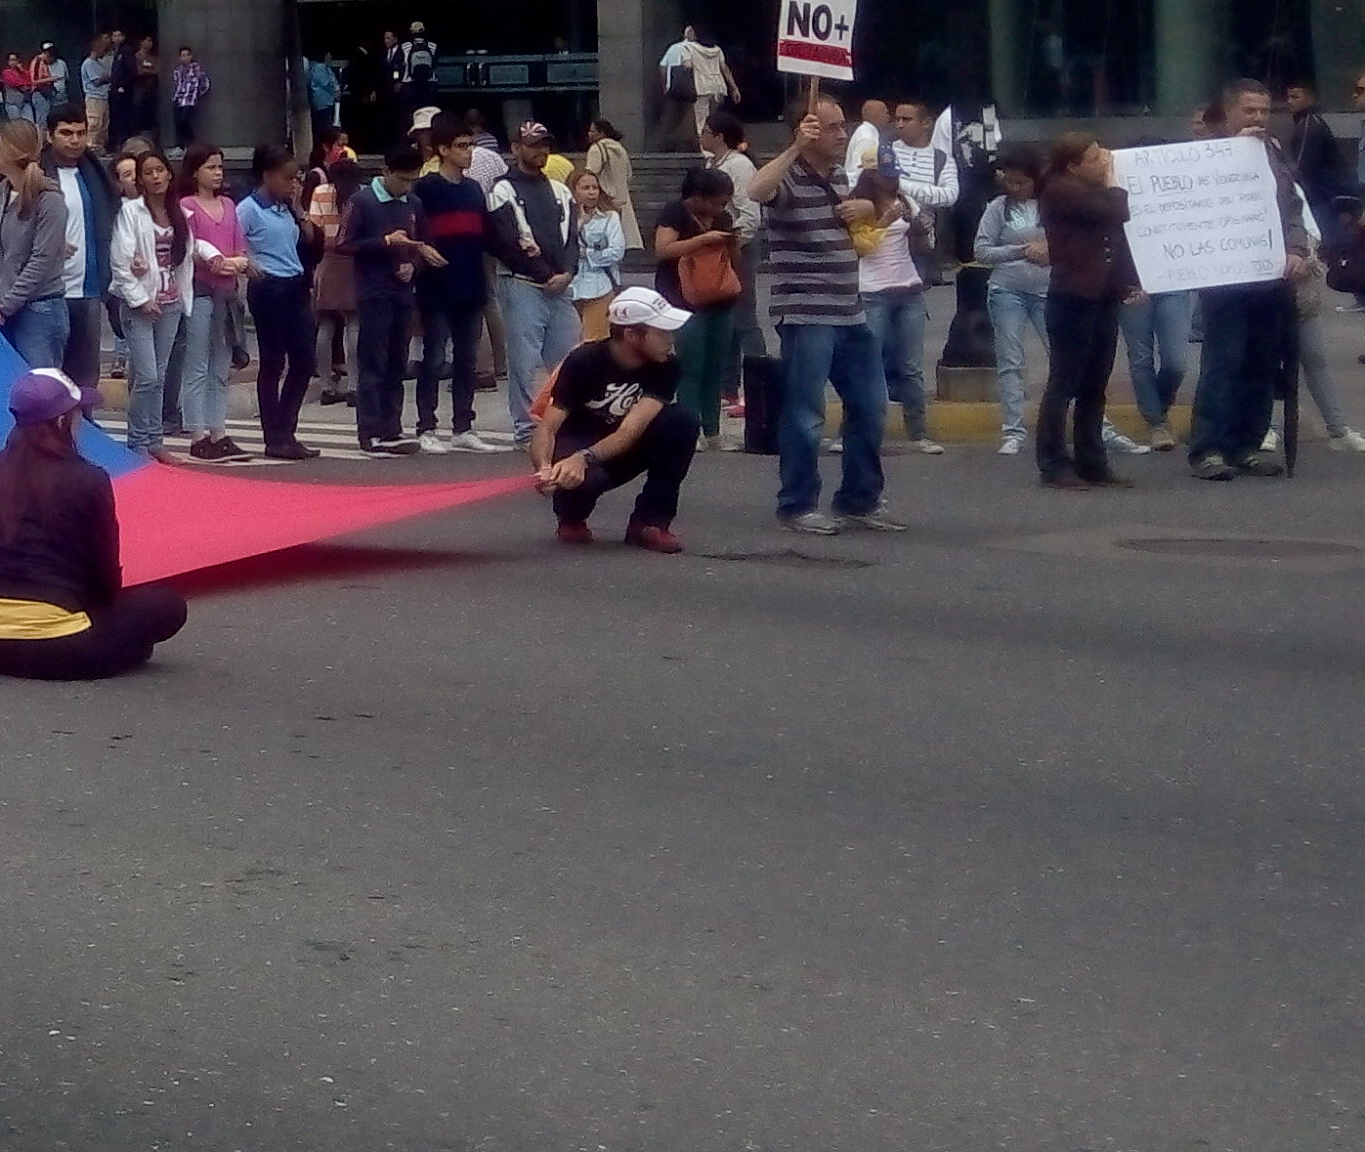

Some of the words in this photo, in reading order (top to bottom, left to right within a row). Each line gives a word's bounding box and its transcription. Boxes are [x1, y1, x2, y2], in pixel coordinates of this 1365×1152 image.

[786, 0, 849, 41] NO+
[1150, 174, 1194, 194] PUEBLO
[1163, 243, 1185, 260] NO
[1189, 241, 1215, 257] LAS
